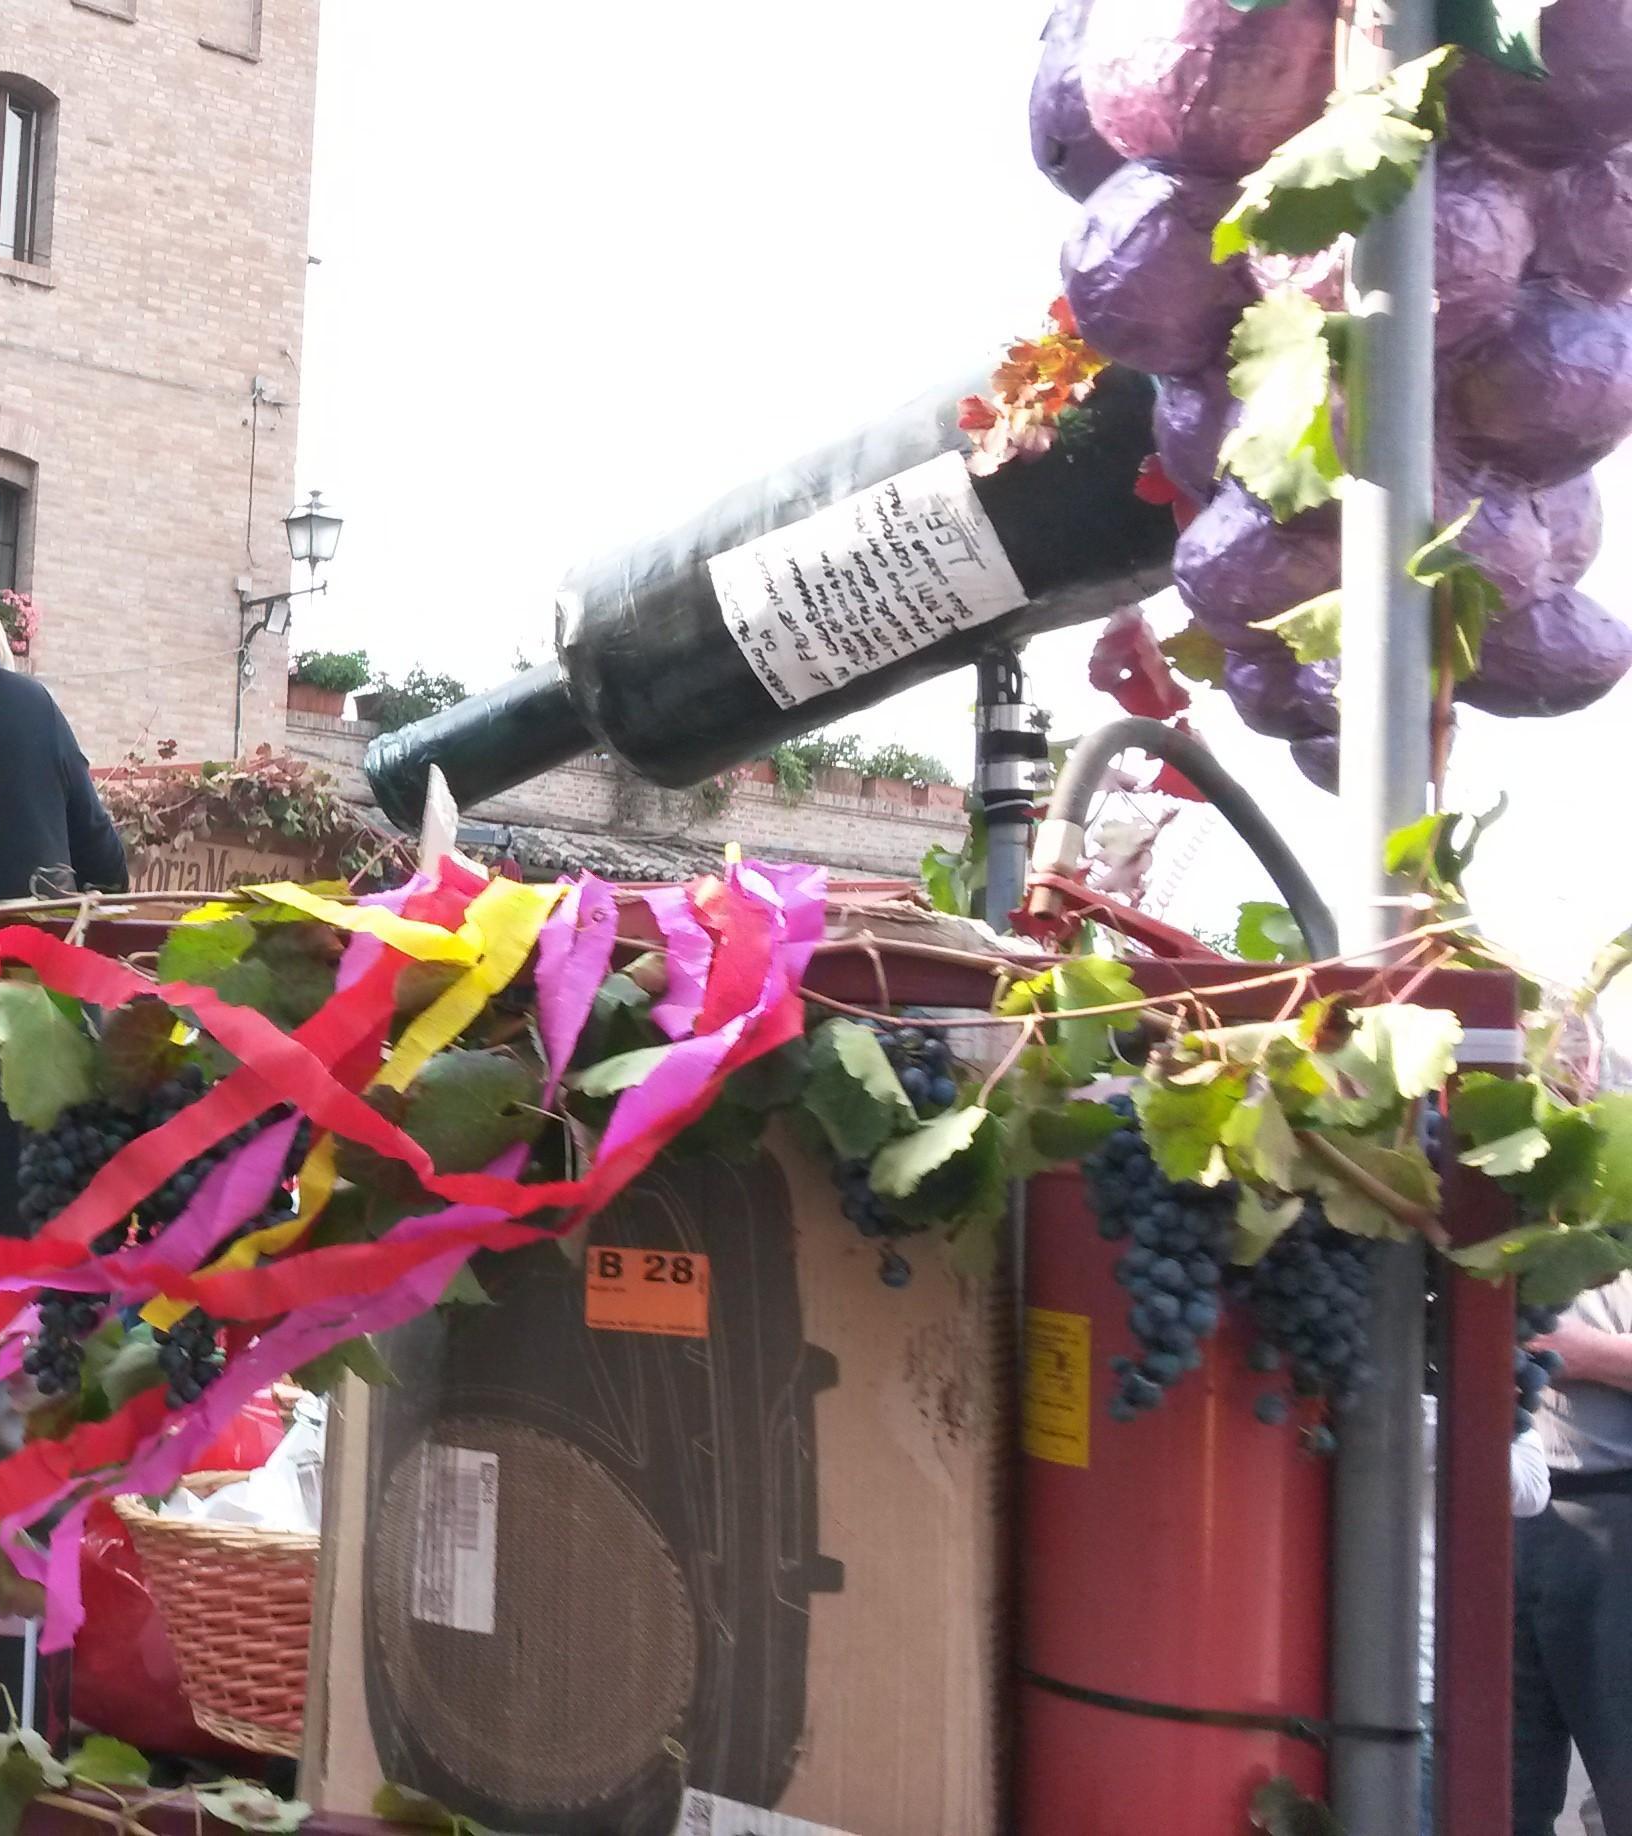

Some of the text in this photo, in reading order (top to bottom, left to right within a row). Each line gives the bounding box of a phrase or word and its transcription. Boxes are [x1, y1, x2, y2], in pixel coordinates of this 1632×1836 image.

[758, 628, 778, 652] DA
[808, 670, 834, 687] LE
[599, 1250, 694, 1284] B 28
